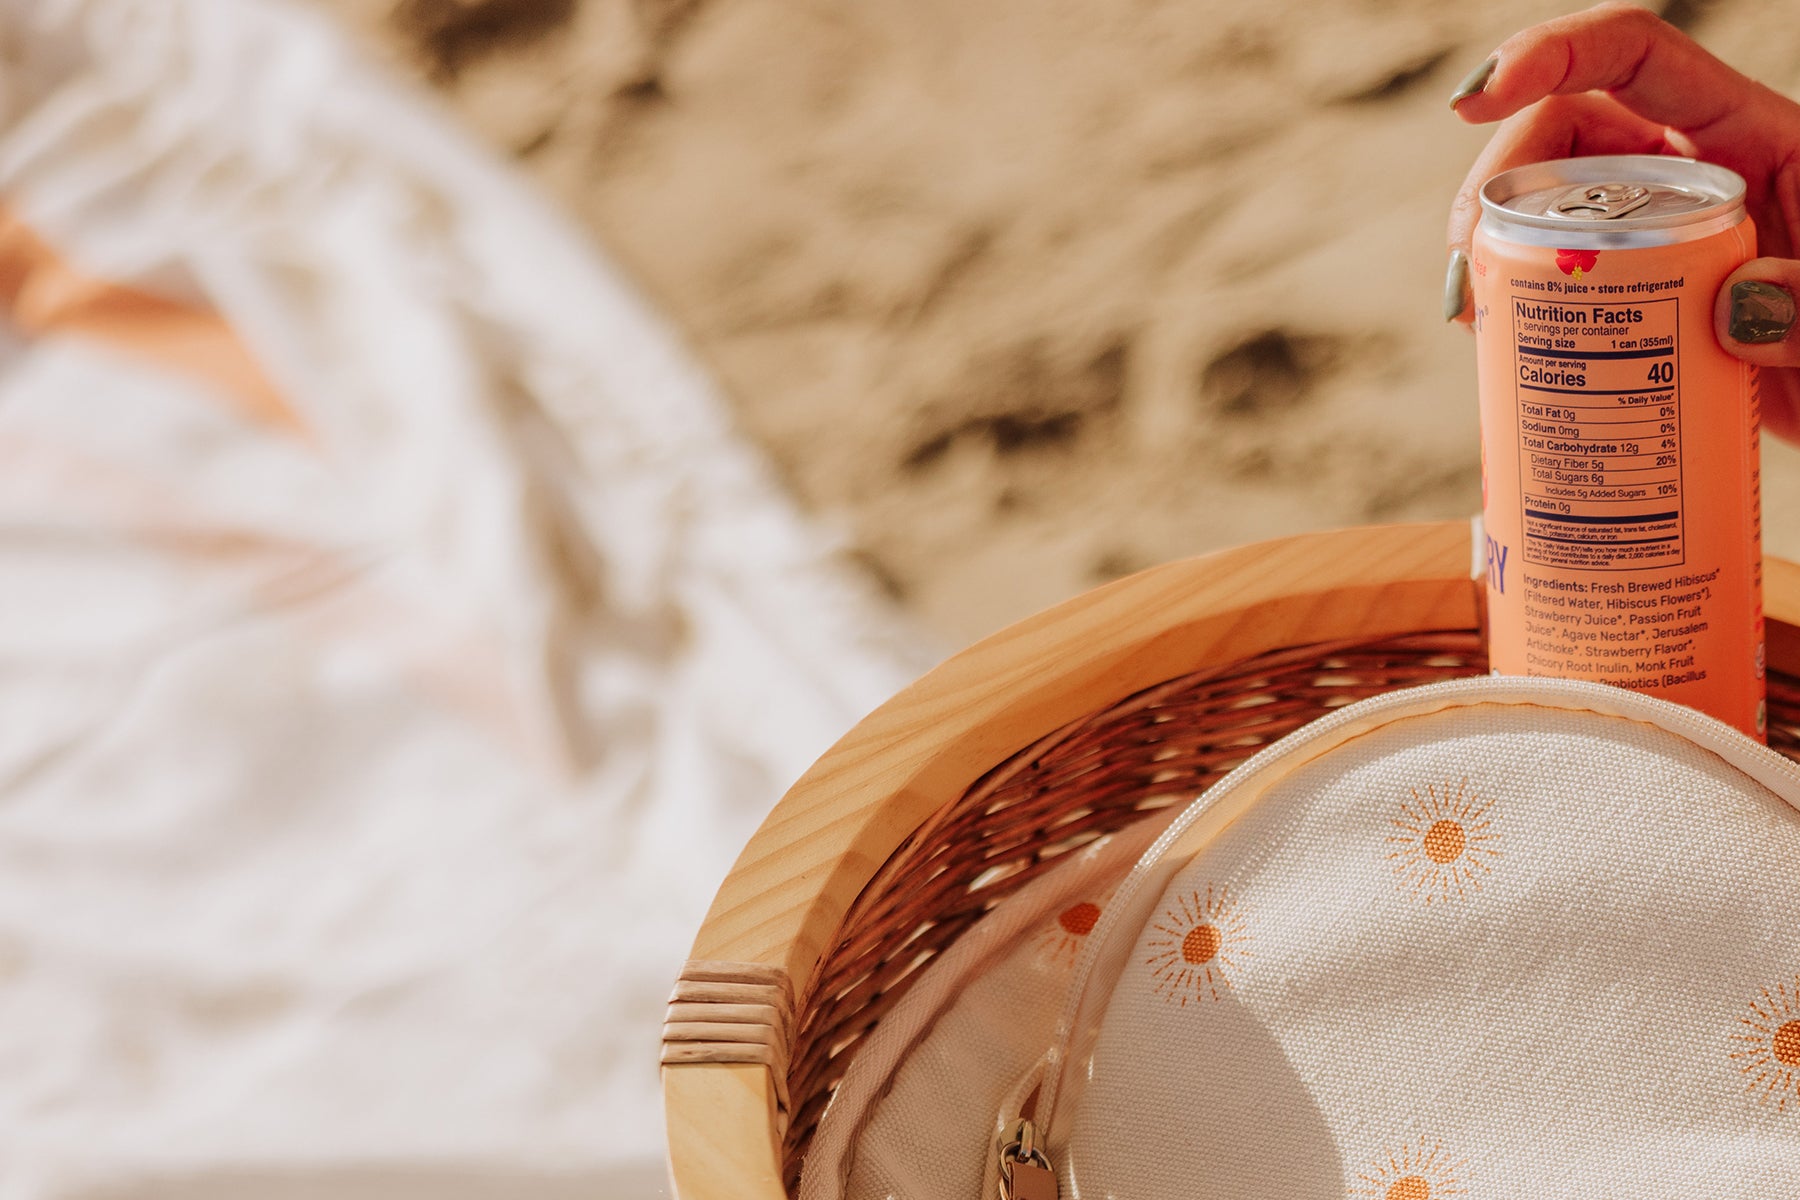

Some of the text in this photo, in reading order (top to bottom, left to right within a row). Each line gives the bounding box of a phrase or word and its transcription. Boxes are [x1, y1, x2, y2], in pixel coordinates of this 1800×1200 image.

[1511, 276, 1684, 294] contains 8% juice store refrigerated
[1516, 301, 1643, 324] Nutrition Facts
[1524, 322, 1560, 336] servings
[1563, 326, 1579, 337] per
[1581, 325, 1629, 336] container
[1518, 332, 1576, 349] Serving size
[1611, 335, 1673, 349] 1 can (355ml)
[1519, 355, 1586, 371] Amount per serving
[1520, 361, 1674, 387] Calories 40
[1628, 396, 1648, 405] Daily
[1521, 403, 1576, 422] Total Fat 0g
[1660, 406, 1675, 417] 0%
[1522, 419, 1579, 438] Sodium 0mg
[1660, 423, 1675, 434] 0%
[1523, 436, 1639, 455] Total Carbohydrate 12g
[1661, 439, 1676, 449] 4%
[1531, 453, 1604, 472] Dietary Fiber 5g
[1656, 454, 1677, 466] 20%
[1531, 466, 1604, 485] Total Sugars 6g
[1545, 486, 1646, 499] Includes 5g Added Sugars
[1657, 483, 1677, 495] 10%
[1525, 496, 1571, 514] Protein 0g
[1523, 573, 1588, 593] Ingredients:
[1591, 582, 1624, 593] Fresh
[1628, 578, 1672, 593] Brewed
[1524, 589, 1565, 607] (Filtered
[1607, 598, 1657, 609] Hibiscus
[1525, 605, 1582, 626] Strawberry
[1629, 612, 1675, 625] Passion
[1677, 606, 1701, 620] Fruit
[1562, 628, 1597, 642] Agave
[1652, 622, 1708, 639] Jerusalem
[1585, 646, 1652, 658] Strawberry
[1526, 653, 1694, 674] Chicory Root Inulin, Monk Fruit
[1662, 670, 1707, 688] (Bacillus
